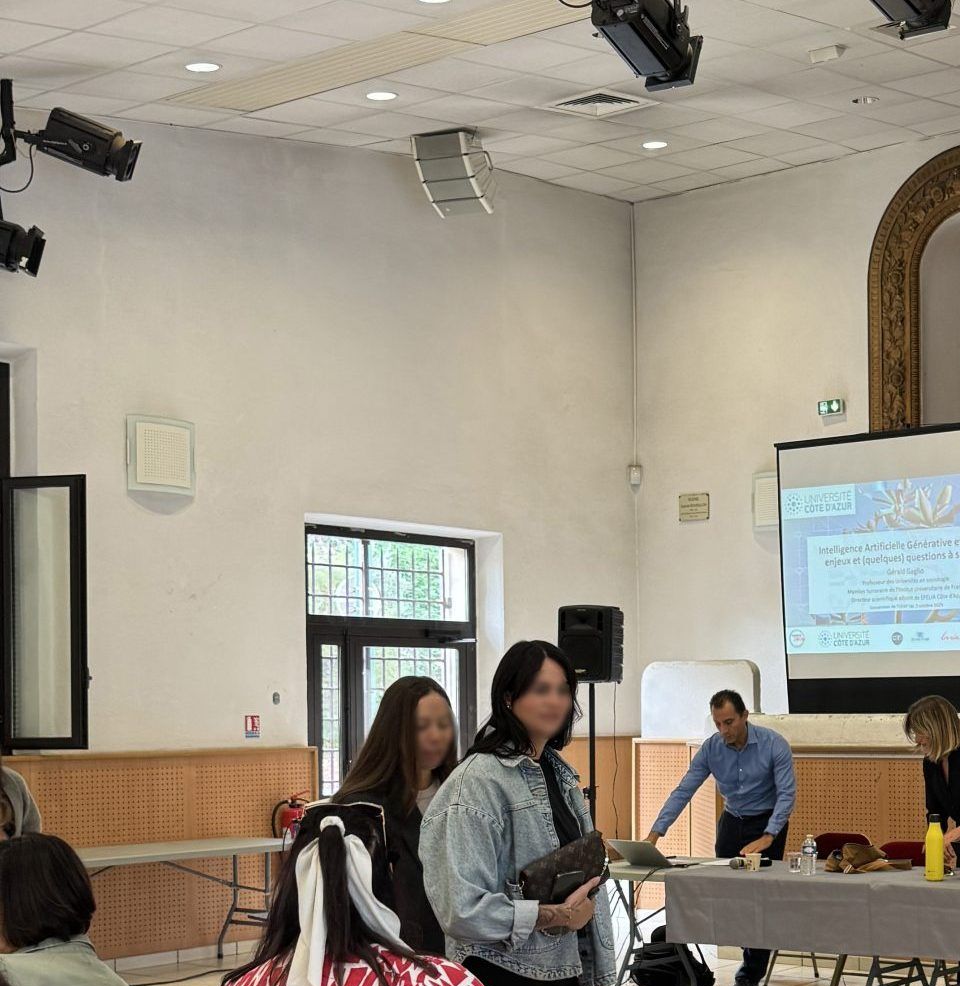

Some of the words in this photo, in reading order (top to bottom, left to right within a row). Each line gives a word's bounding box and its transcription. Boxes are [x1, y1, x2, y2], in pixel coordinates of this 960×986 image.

[803, 490, 852, 504] UNIVERSITÉ
[825, 501, 853, 512] D'AZUR
[818, 544, 863, 556] Intelligence
[864, 540, 905, 552] Artificielle
[906, 537, 952, 550] Générative
[824, 556, 851, 568] enjeux
[852, 556, 861, 565] et
[862, 553, 905, 566] (quelques)
[906, 551, 946, 563] questions
[947, 550, 954, 559] à
